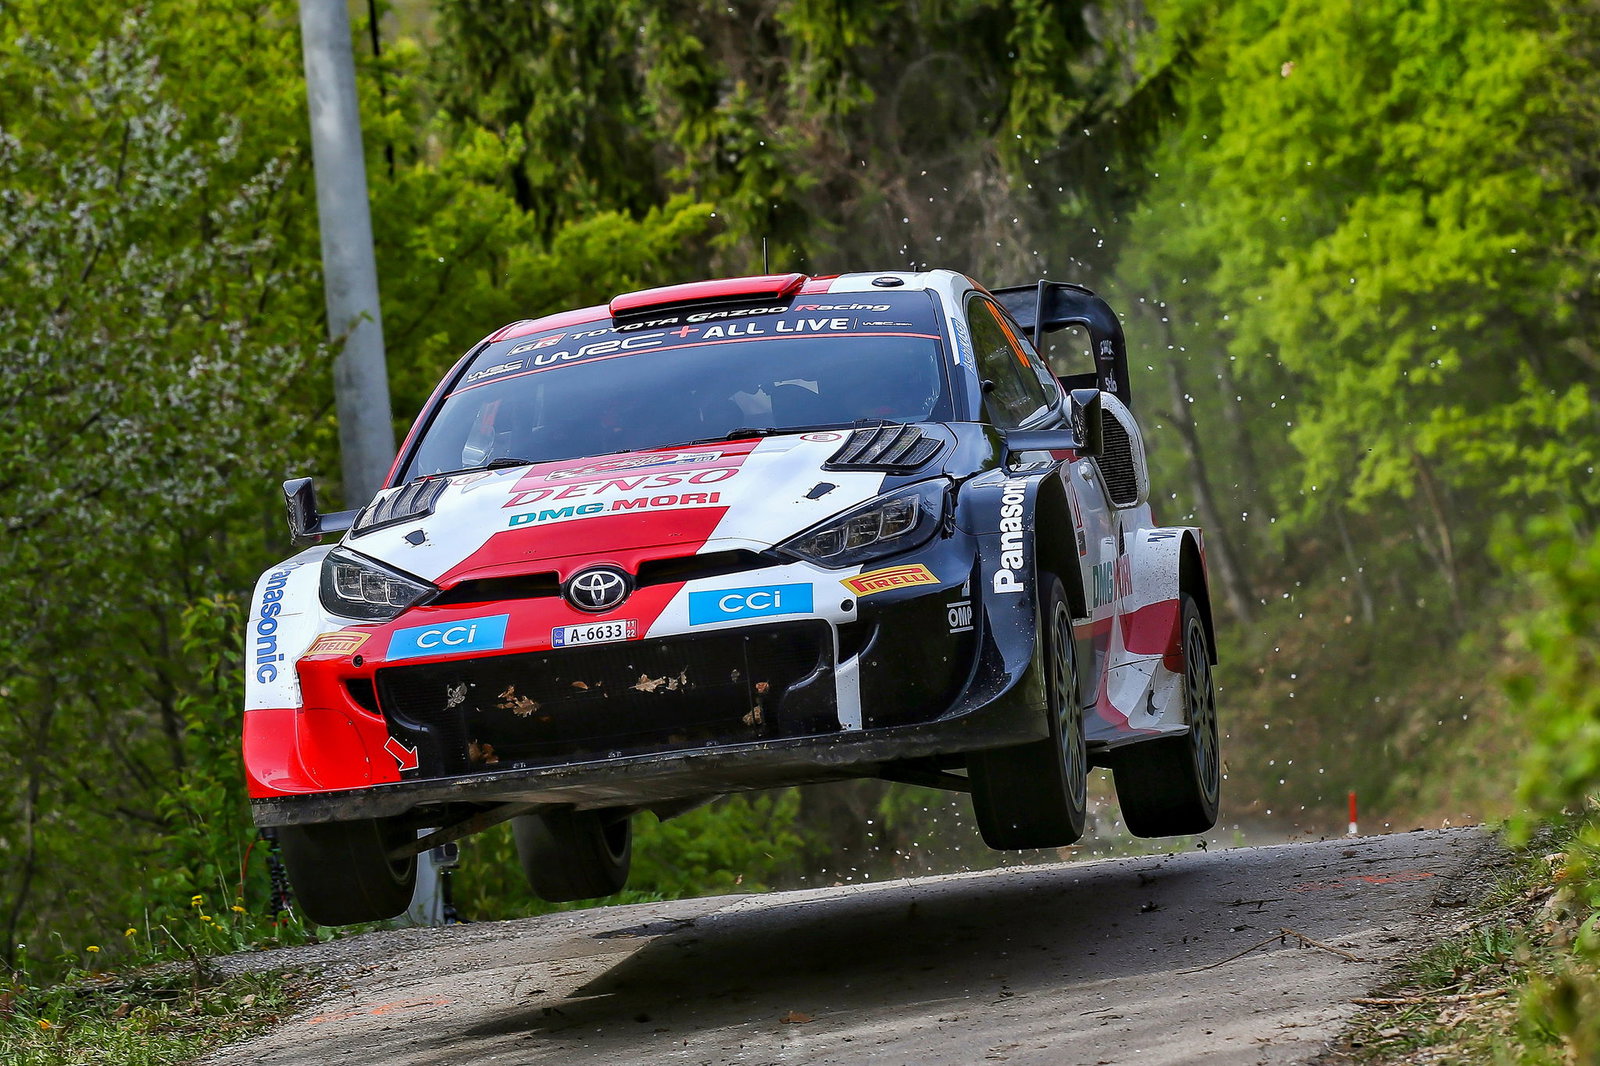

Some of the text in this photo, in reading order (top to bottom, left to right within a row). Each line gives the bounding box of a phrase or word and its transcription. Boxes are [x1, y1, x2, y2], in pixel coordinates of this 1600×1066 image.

[511, 334, 564, 354] GR
[570, 317, 679, 340] TOYOTA
[794, 303, 891, 312] Racing
[702, 320, 765, 339] ALL
[775, 318, 850, 332] LIVE
[501, 468, 740, 508] DENSO
[849, 568, 931, 592] PIRELLI
[947, 604, 973, 628] OMP
[570, 625, 622, 643] A-6633
[626, 629, 636, 637] 22
